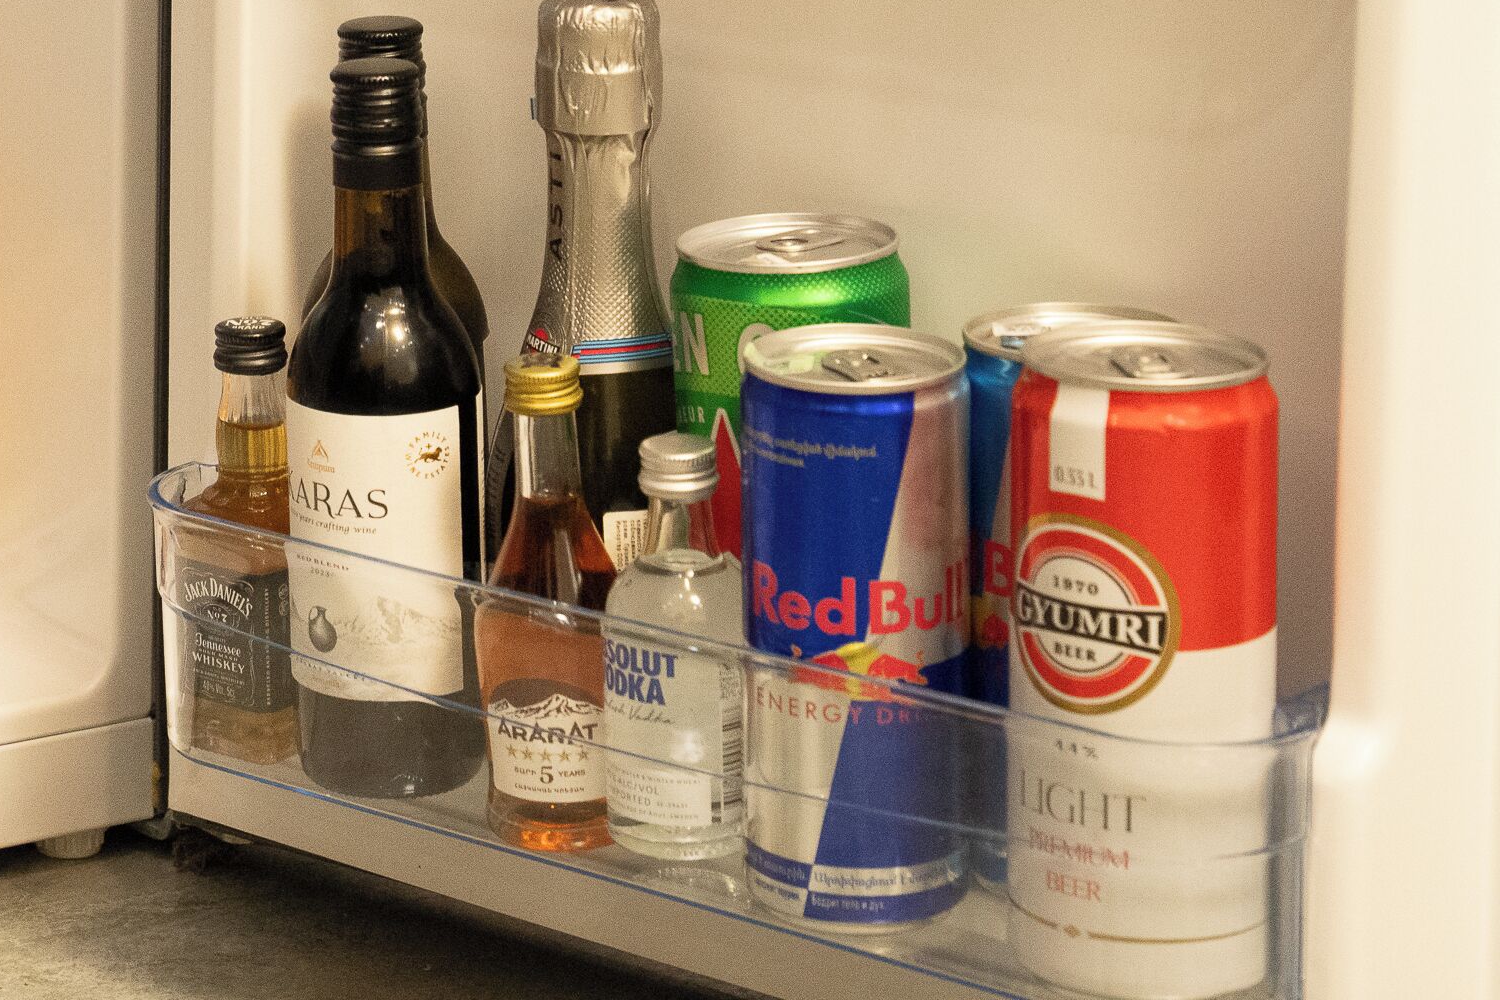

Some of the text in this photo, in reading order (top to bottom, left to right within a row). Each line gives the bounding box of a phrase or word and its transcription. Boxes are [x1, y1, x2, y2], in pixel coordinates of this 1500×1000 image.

[549, 150, 564, 262] ASTI
[408, 431, 448, 448] FAMILY
[424, 445, 450, 480] ESTATES
[315, 519, 377, 534] crafting wine
[184, 580, 209, 603] JACK
[753, 559, 857, 636] Red
[869, 555, 970, 636] Bull
[1053, 575, 1099, 597] 1970
[221, 613, 228, 623] 7
[1019, 588, 1164, 651] GYUMRI
[192, 650, 245, 675] WHISKEY
[604, 638, 679, 679] SOLUT
[1054, 642, 1097, 662] BEER
[604, 663, 667, 706] ODKA
[754, 685, 862, 726] ENERGY
[498, 717, 599, 745] ARARAT
[540, 765, 586, 785] 5 YEARS
